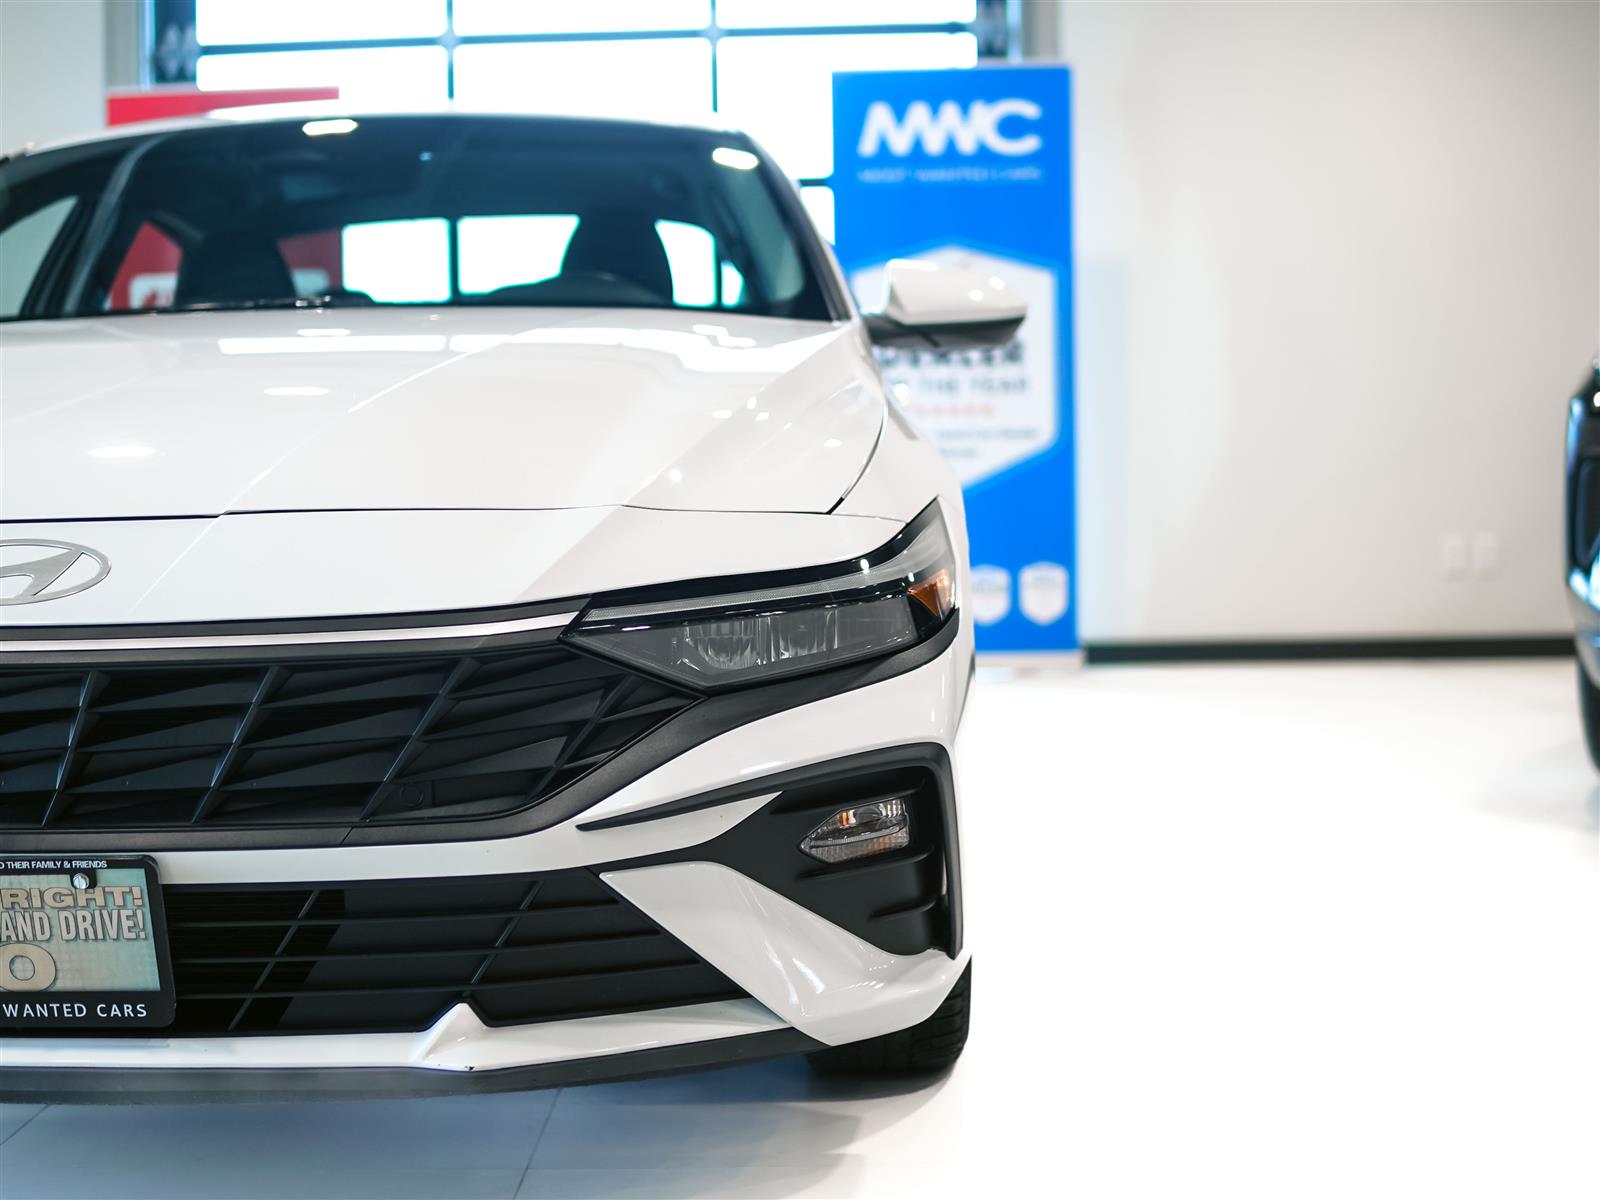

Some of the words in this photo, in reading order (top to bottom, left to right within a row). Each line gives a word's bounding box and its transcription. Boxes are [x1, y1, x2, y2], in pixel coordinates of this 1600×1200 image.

[858, 98, 1042, 157] MWC
[6, 861, 30, 869] THEIR
[31, 860, 62, 869] FAMILY
[63, 860, 71, 869] &
[72, 860, 108, 869] FRIENDS
[1, 886, 143, 909] RIGHT!
[1, 911, 51, 942] AND
[58, 909, 146, 940] DRIVE!
[3, 1003, 87, 1018] WANTED
[96, 1003, 147, 1017] CARS
